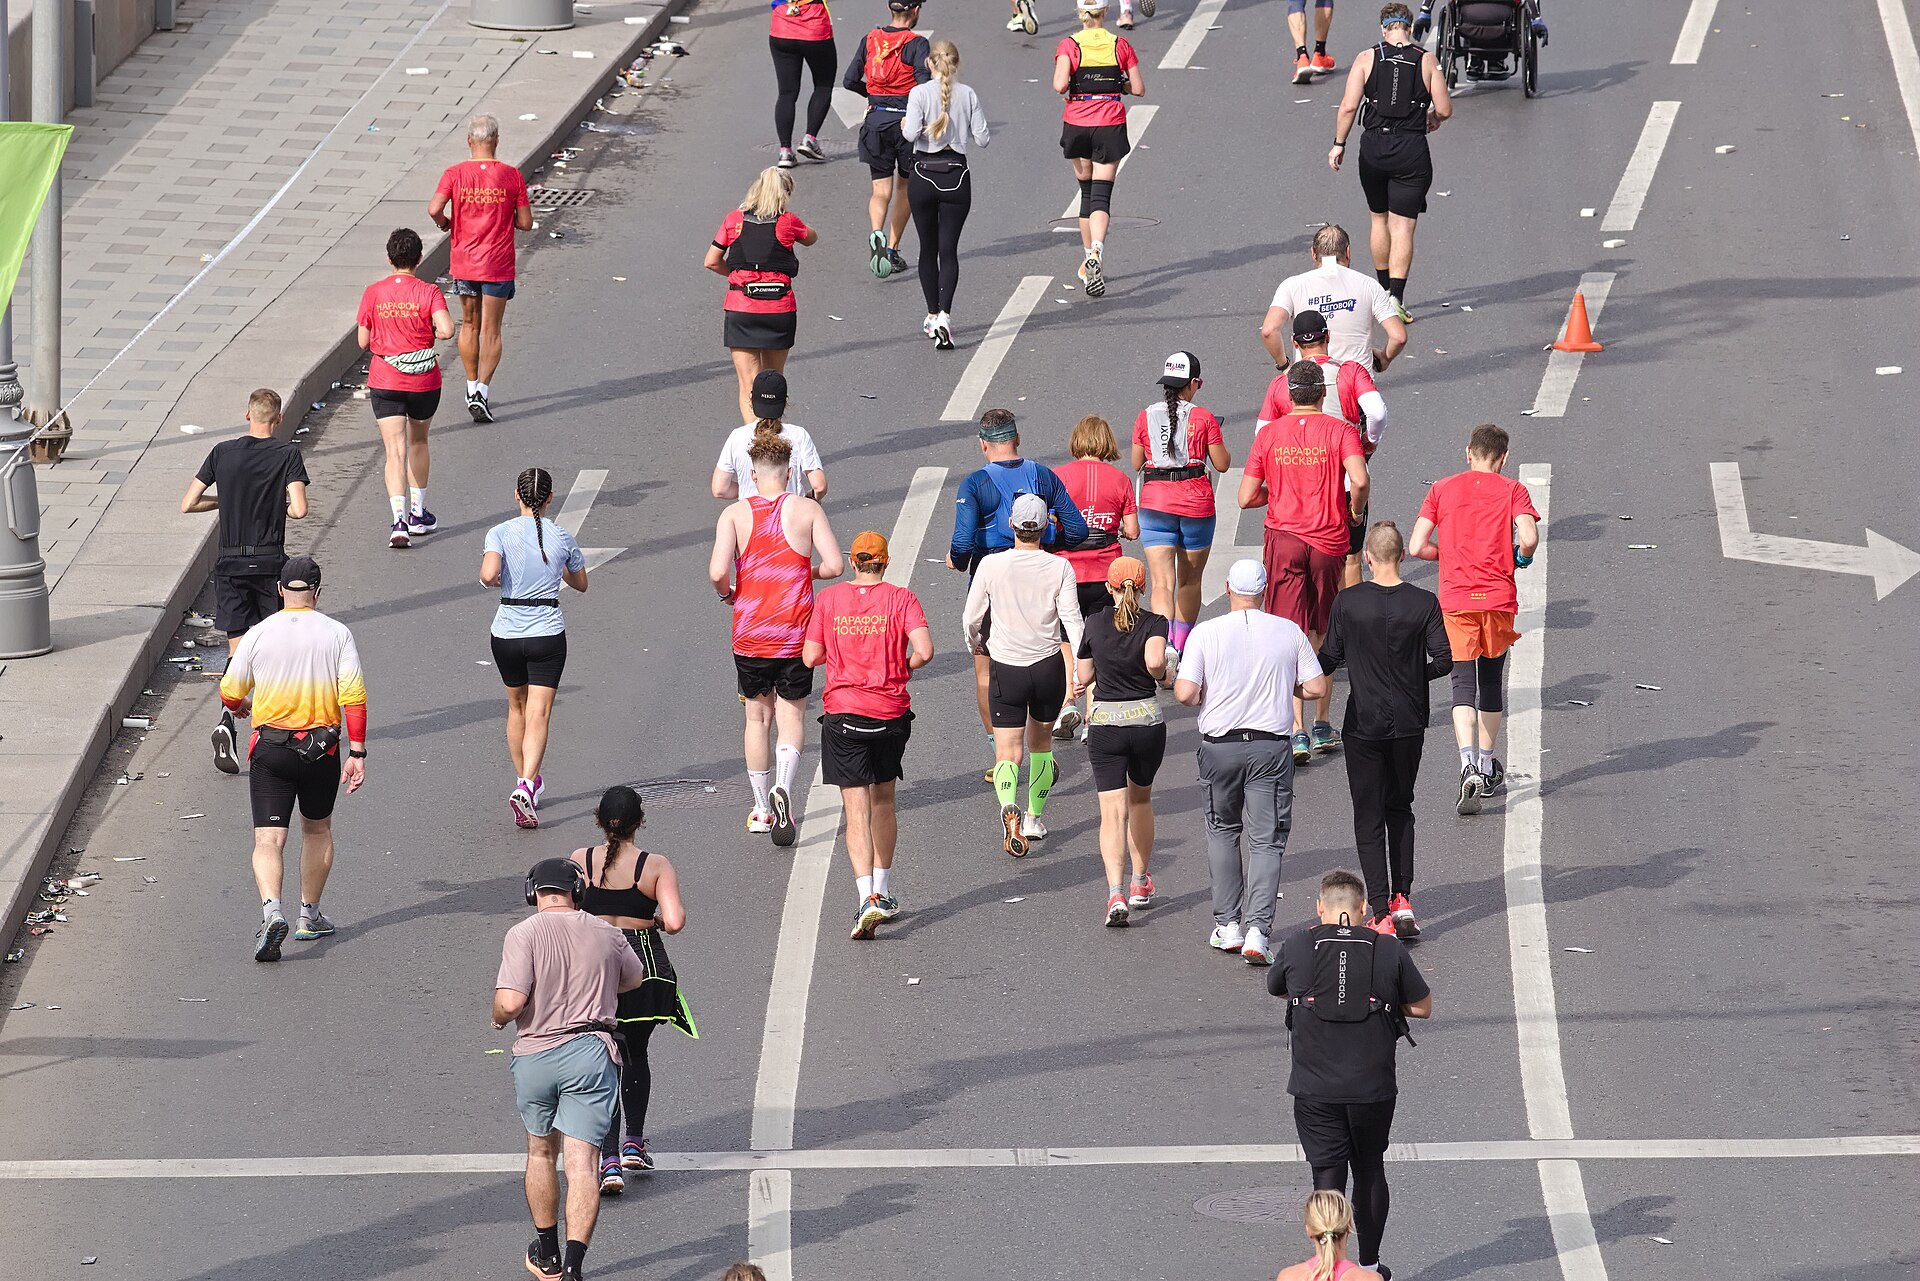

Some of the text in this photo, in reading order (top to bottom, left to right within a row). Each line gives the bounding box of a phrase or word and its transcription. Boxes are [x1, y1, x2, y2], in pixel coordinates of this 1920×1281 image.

[460, 187, 507, 197] МАРАФОН
[460, 195, 499, 204] МОСКВА
[1308, 294, 1332, 306] #ВТБ
[1320, 300, 1354, 312] БЕГОВОЙ
[1274, 446, 1327, 456] МАРАФОН
[1275, 455, 1320, 466] МОСКВА
[833, 615, 888, 625] МАРАФОН
[832, 625, 879, 635] МОСКВА
[1338, 950, 1347, 1006] TOPSPEED
